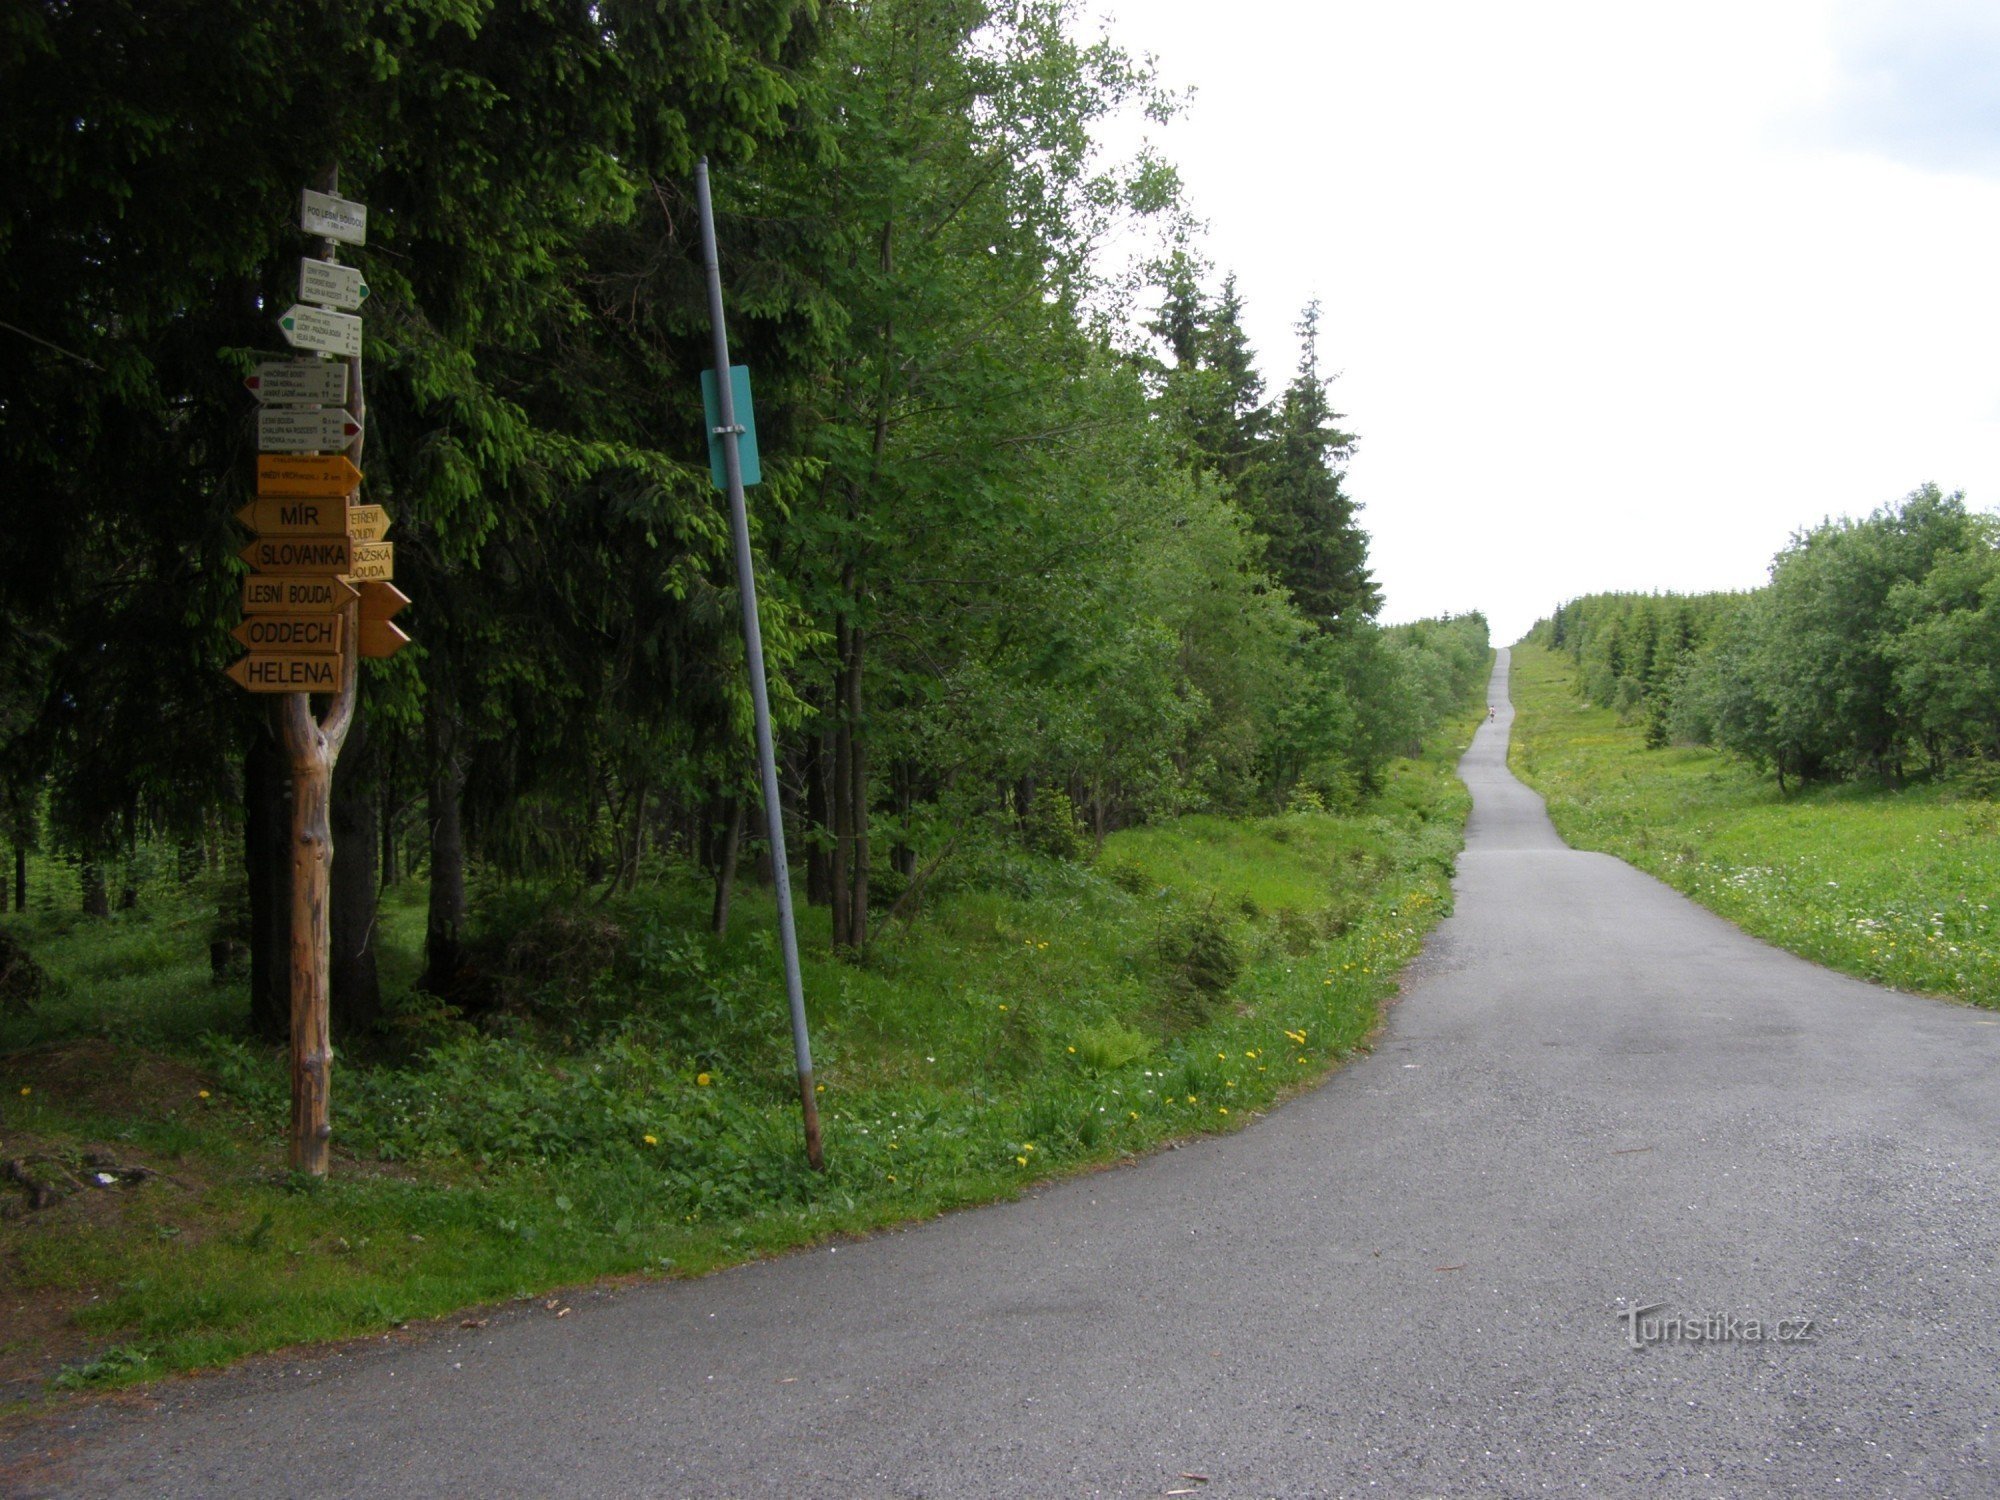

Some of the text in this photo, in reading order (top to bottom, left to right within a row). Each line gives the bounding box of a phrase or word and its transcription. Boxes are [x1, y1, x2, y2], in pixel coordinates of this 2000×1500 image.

[308, 206, 320, 216] POD
[322, 210, 338, 220] LESNÍ
[340, 214, 364, 228] BOUDOU
[281, 503, 319, 526] MÍR
[261, 544, 346, 566] SLOVANKA
[248, 582, 332, 604] LESNÍ BOUDA
[250, 622, 332, 643] ODDECH
[250, 662, 334, 684] HELENA
